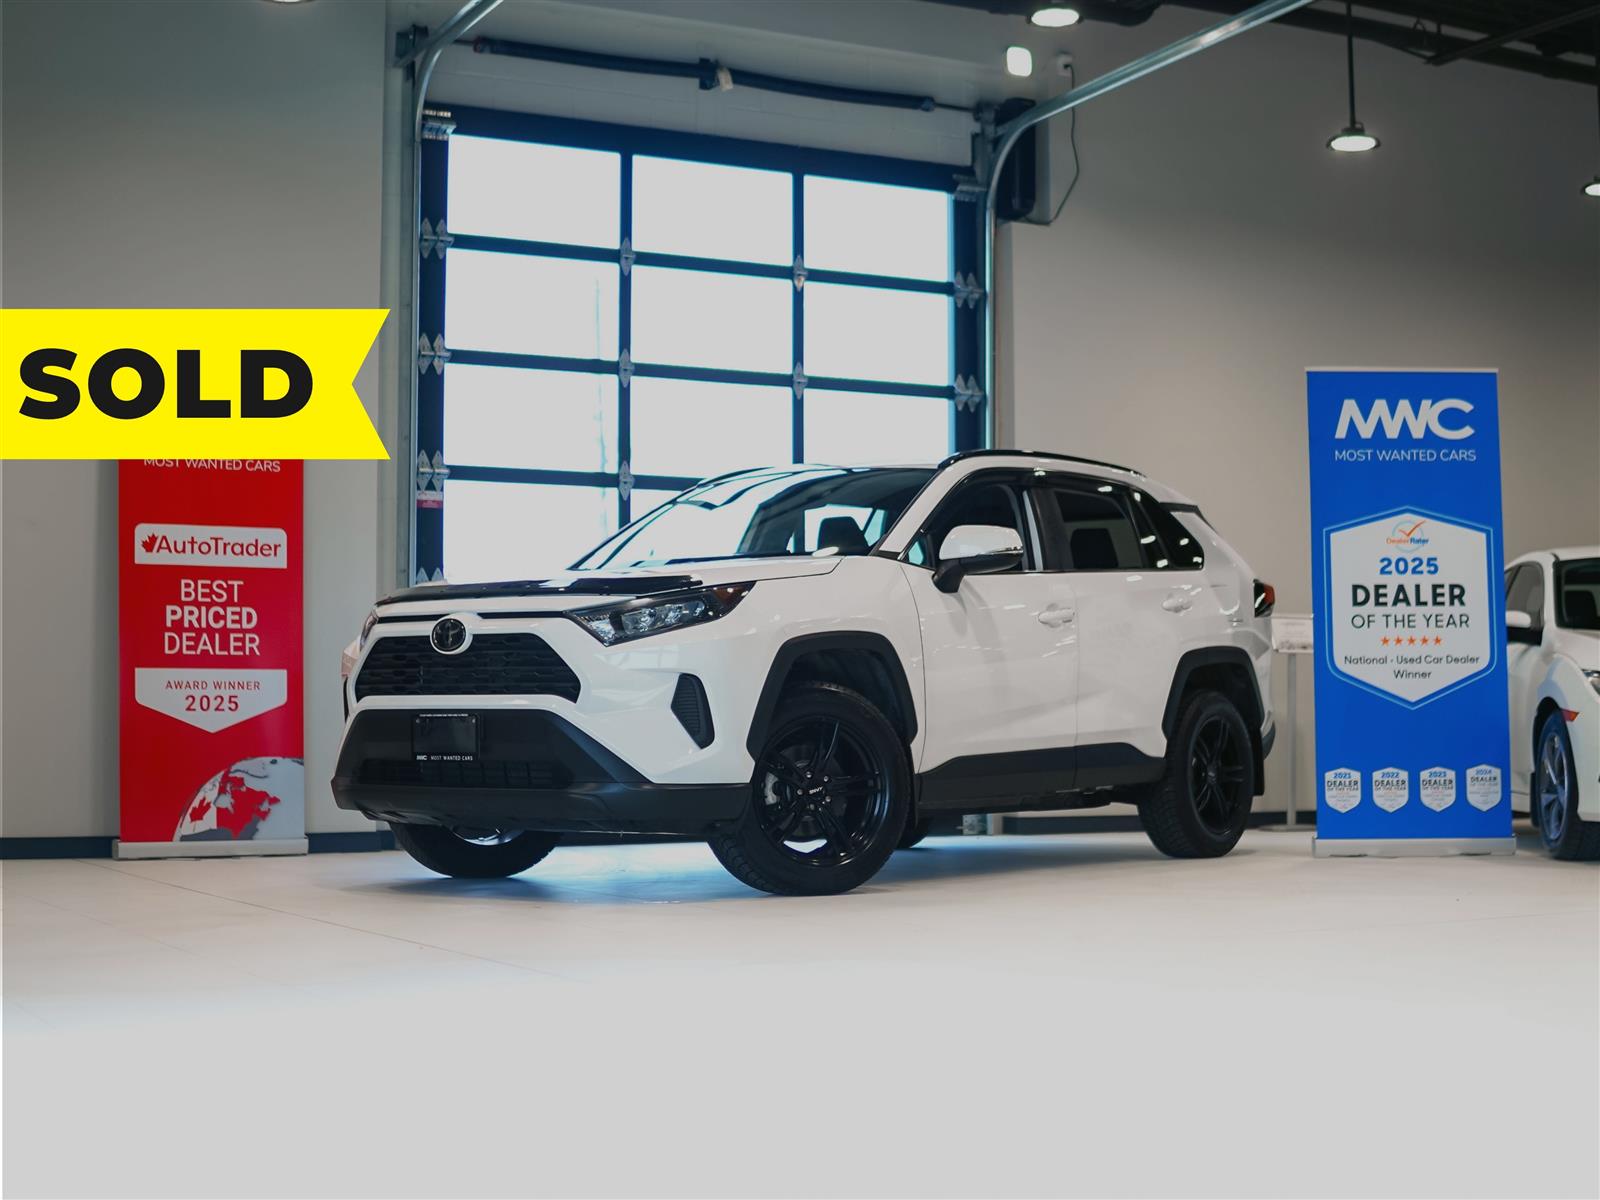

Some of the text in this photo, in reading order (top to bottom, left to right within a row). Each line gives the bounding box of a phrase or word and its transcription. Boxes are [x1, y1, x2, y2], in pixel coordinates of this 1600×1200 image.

[1335, 398, 1475, 440] MWC
[1335, 449, 1477, 462] MOST WANTED CARS
[143, 459, 281, 473] MOST WANTED CARS
[156, 535, 281, 558] AutoTrader
[1379, 557, 1439, 575] 2025
[180, 578, 244, 603] BEST
[1352, 584, 1466, 607] DEALER
[165, 604, 258, 629] PRICED
[1351, 614, 1470, 629] OF THE YEAR
[164, 632, 261, 656] DEALER
[1344, 655, 1388, 665] National
[1396, 655, 1422, 665] Used
[1424, 655, 1443, 665] Car
[1445, 655, 1480, 665] Dealer
[1393, 669, 1432, 679] Winner
[165, 680, 261, 691] AWARD WINNER
[185, 695, 239, 712] 2025
